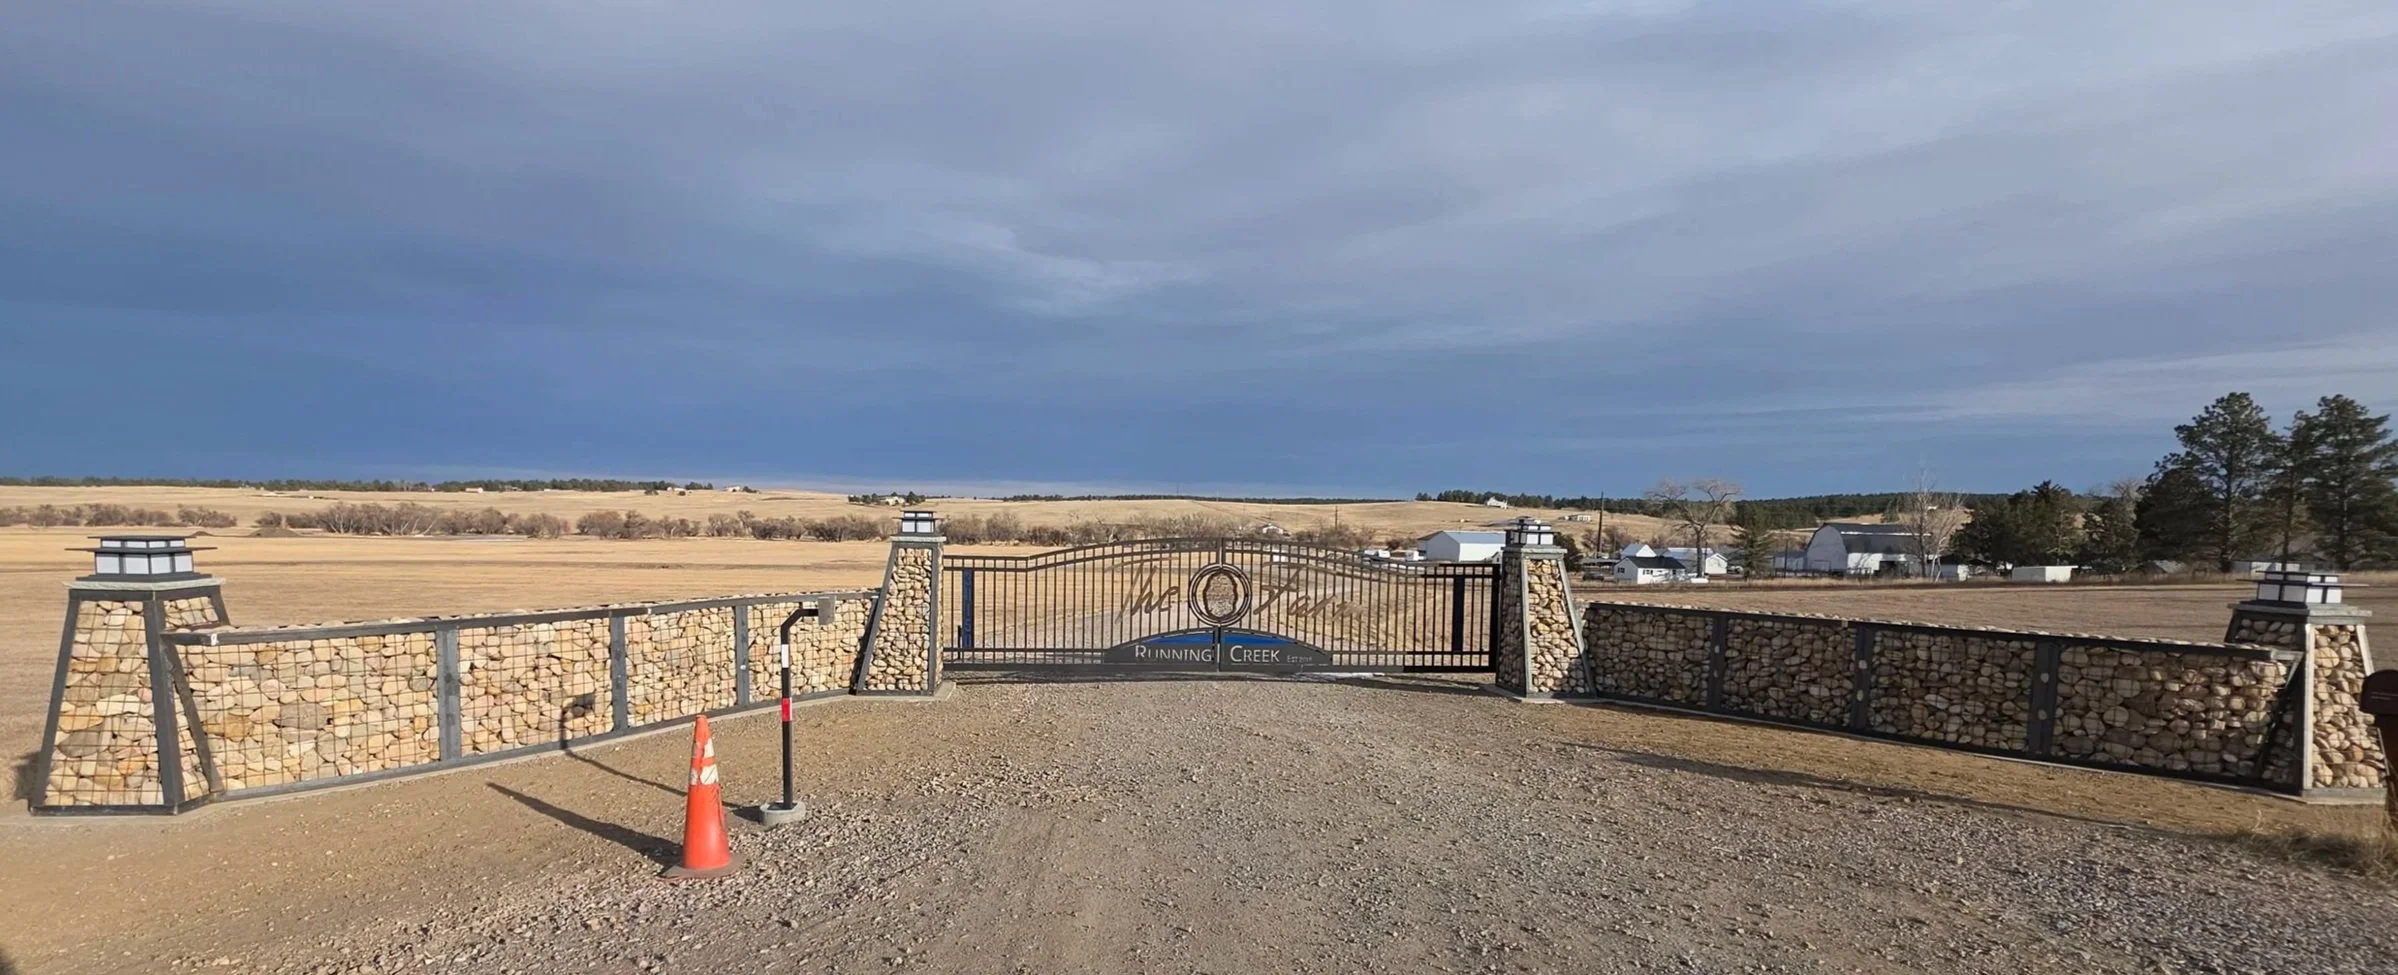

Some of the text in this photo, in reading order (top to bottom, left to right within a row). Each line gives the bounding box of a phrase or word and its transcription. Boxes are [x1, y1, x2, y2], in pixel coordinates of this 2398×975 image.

[1104, 556, 1180, 624] The
[1135, 645, 1212, 662] RUNNING
[1230, 645, 1280, 662] CREEK
